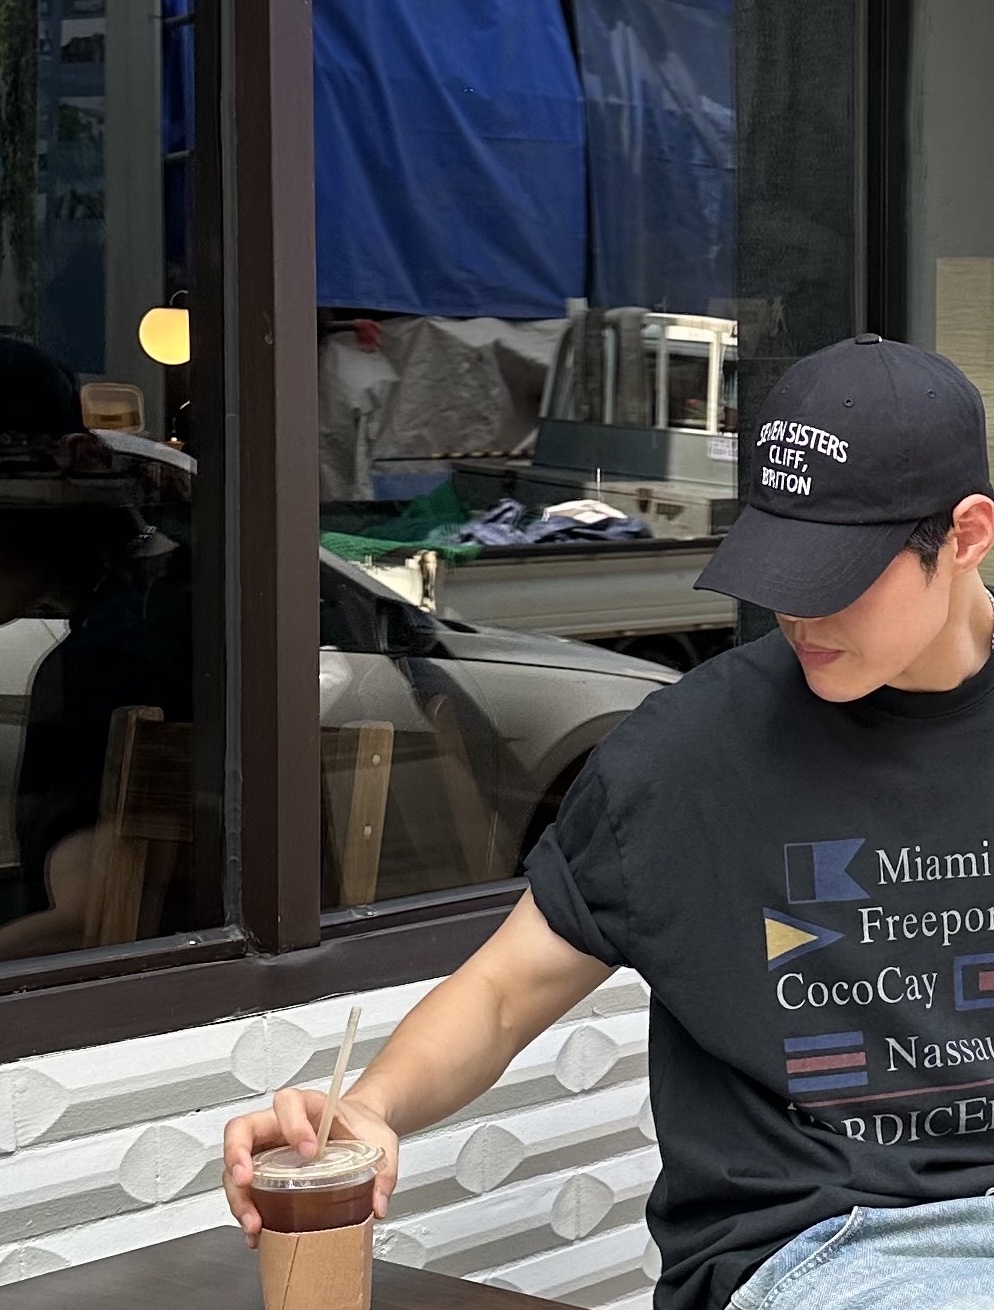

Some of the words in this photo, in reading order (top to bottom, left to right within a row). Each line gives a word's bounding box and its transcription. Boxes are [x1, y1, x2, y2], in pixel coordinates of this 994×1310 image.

[769, 445, 808, 473] CLIFF,
[786, 423, 849, 463] SISTERS
[761, 466, 812, 496] BRITON
[876, 840, 991, 885] Miami
[776, 966, 938, 1010] CocoCay
